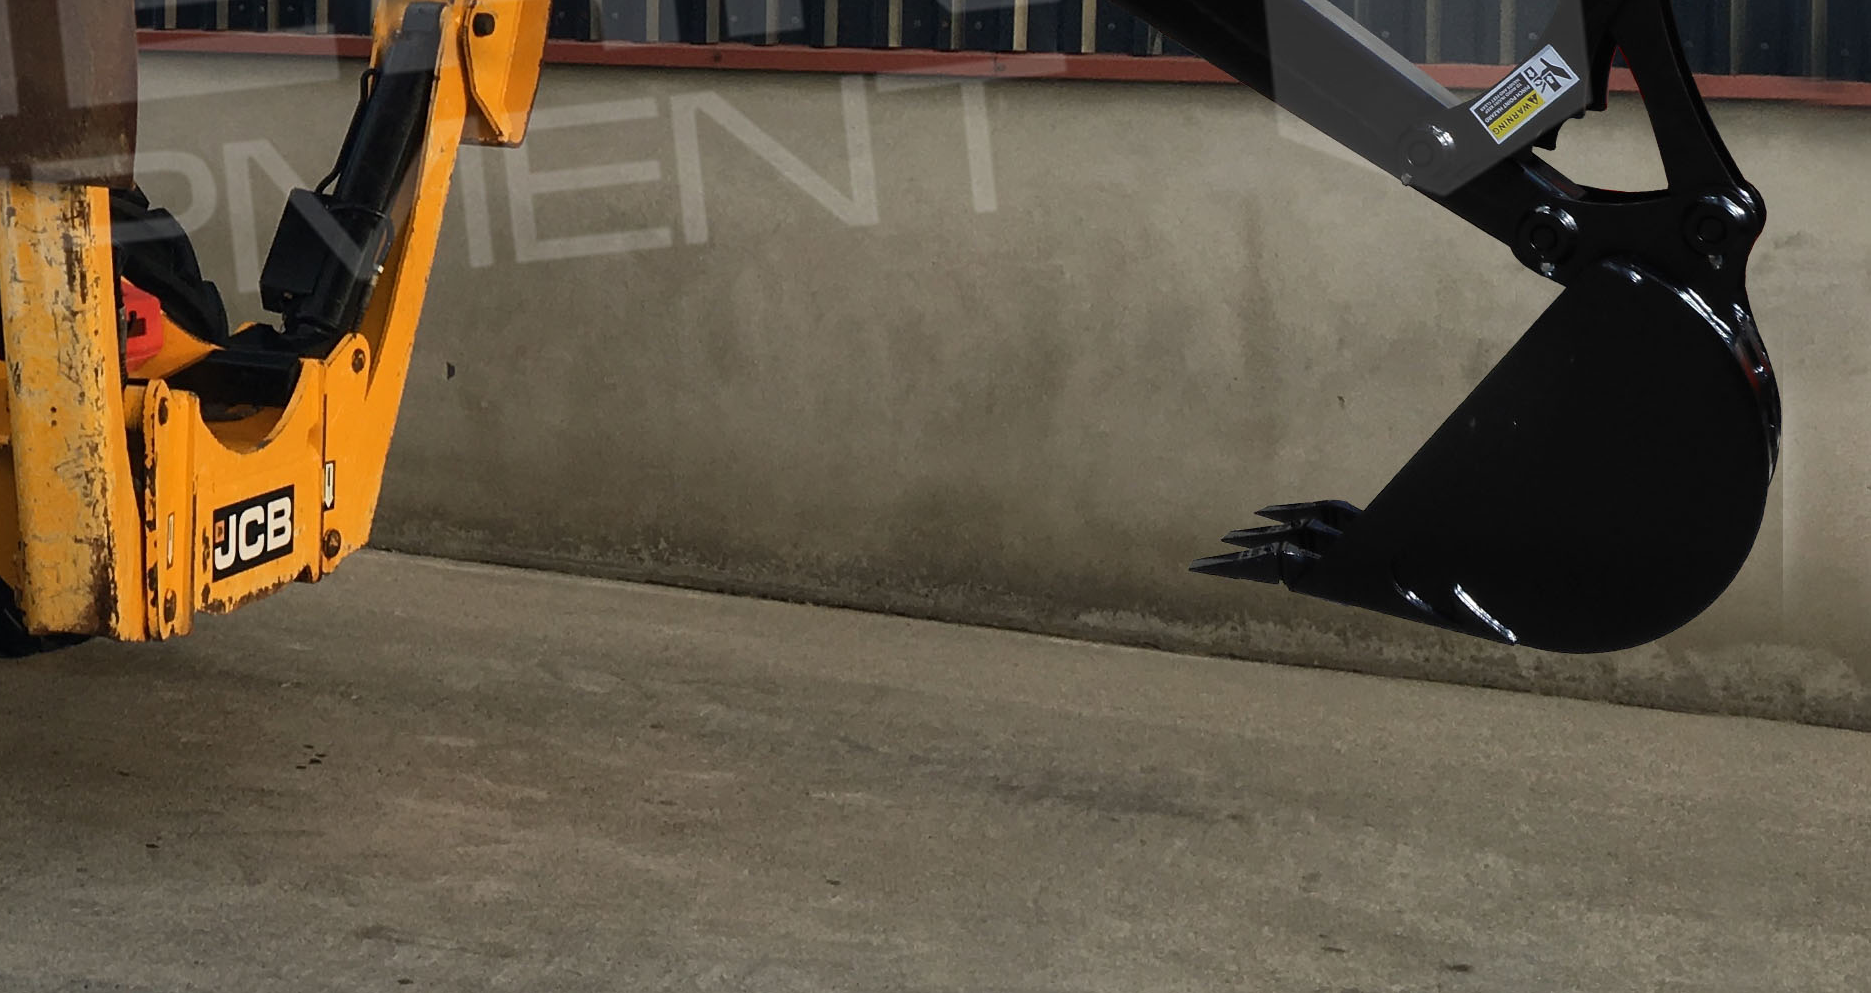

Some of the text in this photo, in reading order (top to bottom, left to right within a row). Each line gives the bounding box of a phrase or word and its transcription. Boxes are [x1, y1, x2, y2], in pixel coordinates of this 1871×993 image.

[1484, 105, 1504, 123] HAZARD
[1502, 95, 1517, 108] POINT
[1492, 102, 1533, 135] WARNING
[214, 496, 292, 571] JCB
